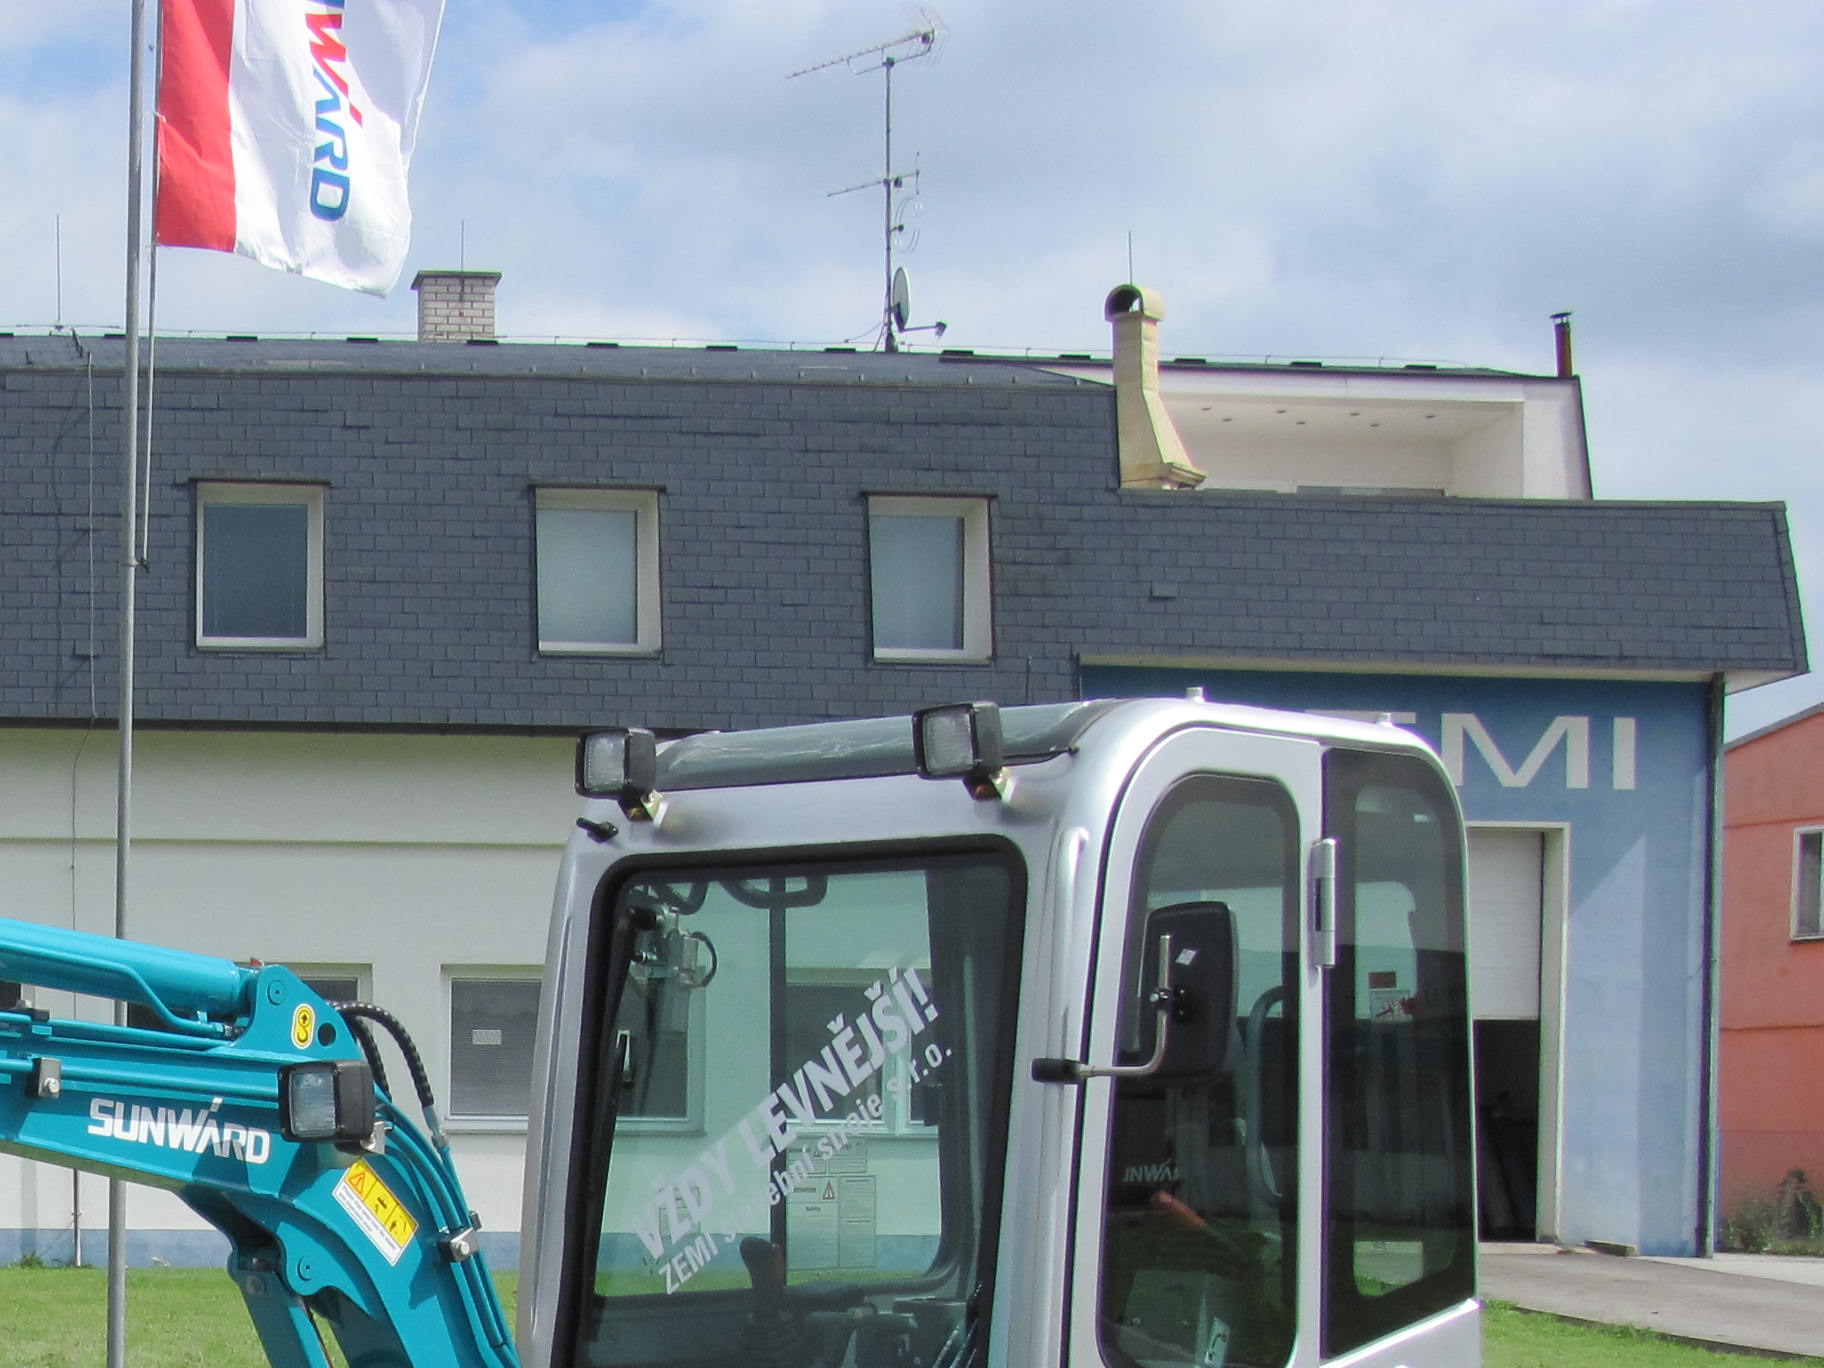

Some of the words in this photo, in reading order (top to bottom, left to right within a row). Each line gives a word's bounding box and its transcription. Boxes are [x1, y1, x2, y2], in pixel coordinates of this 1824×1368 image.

[303, 0, 363, 222] WARD
[87, 1097, 271, 1165] SUNWARD
[738, 965, 939, 1168] LEVNĚJŠÍ!
[659, 1232, 719, 1295] ZEMI
